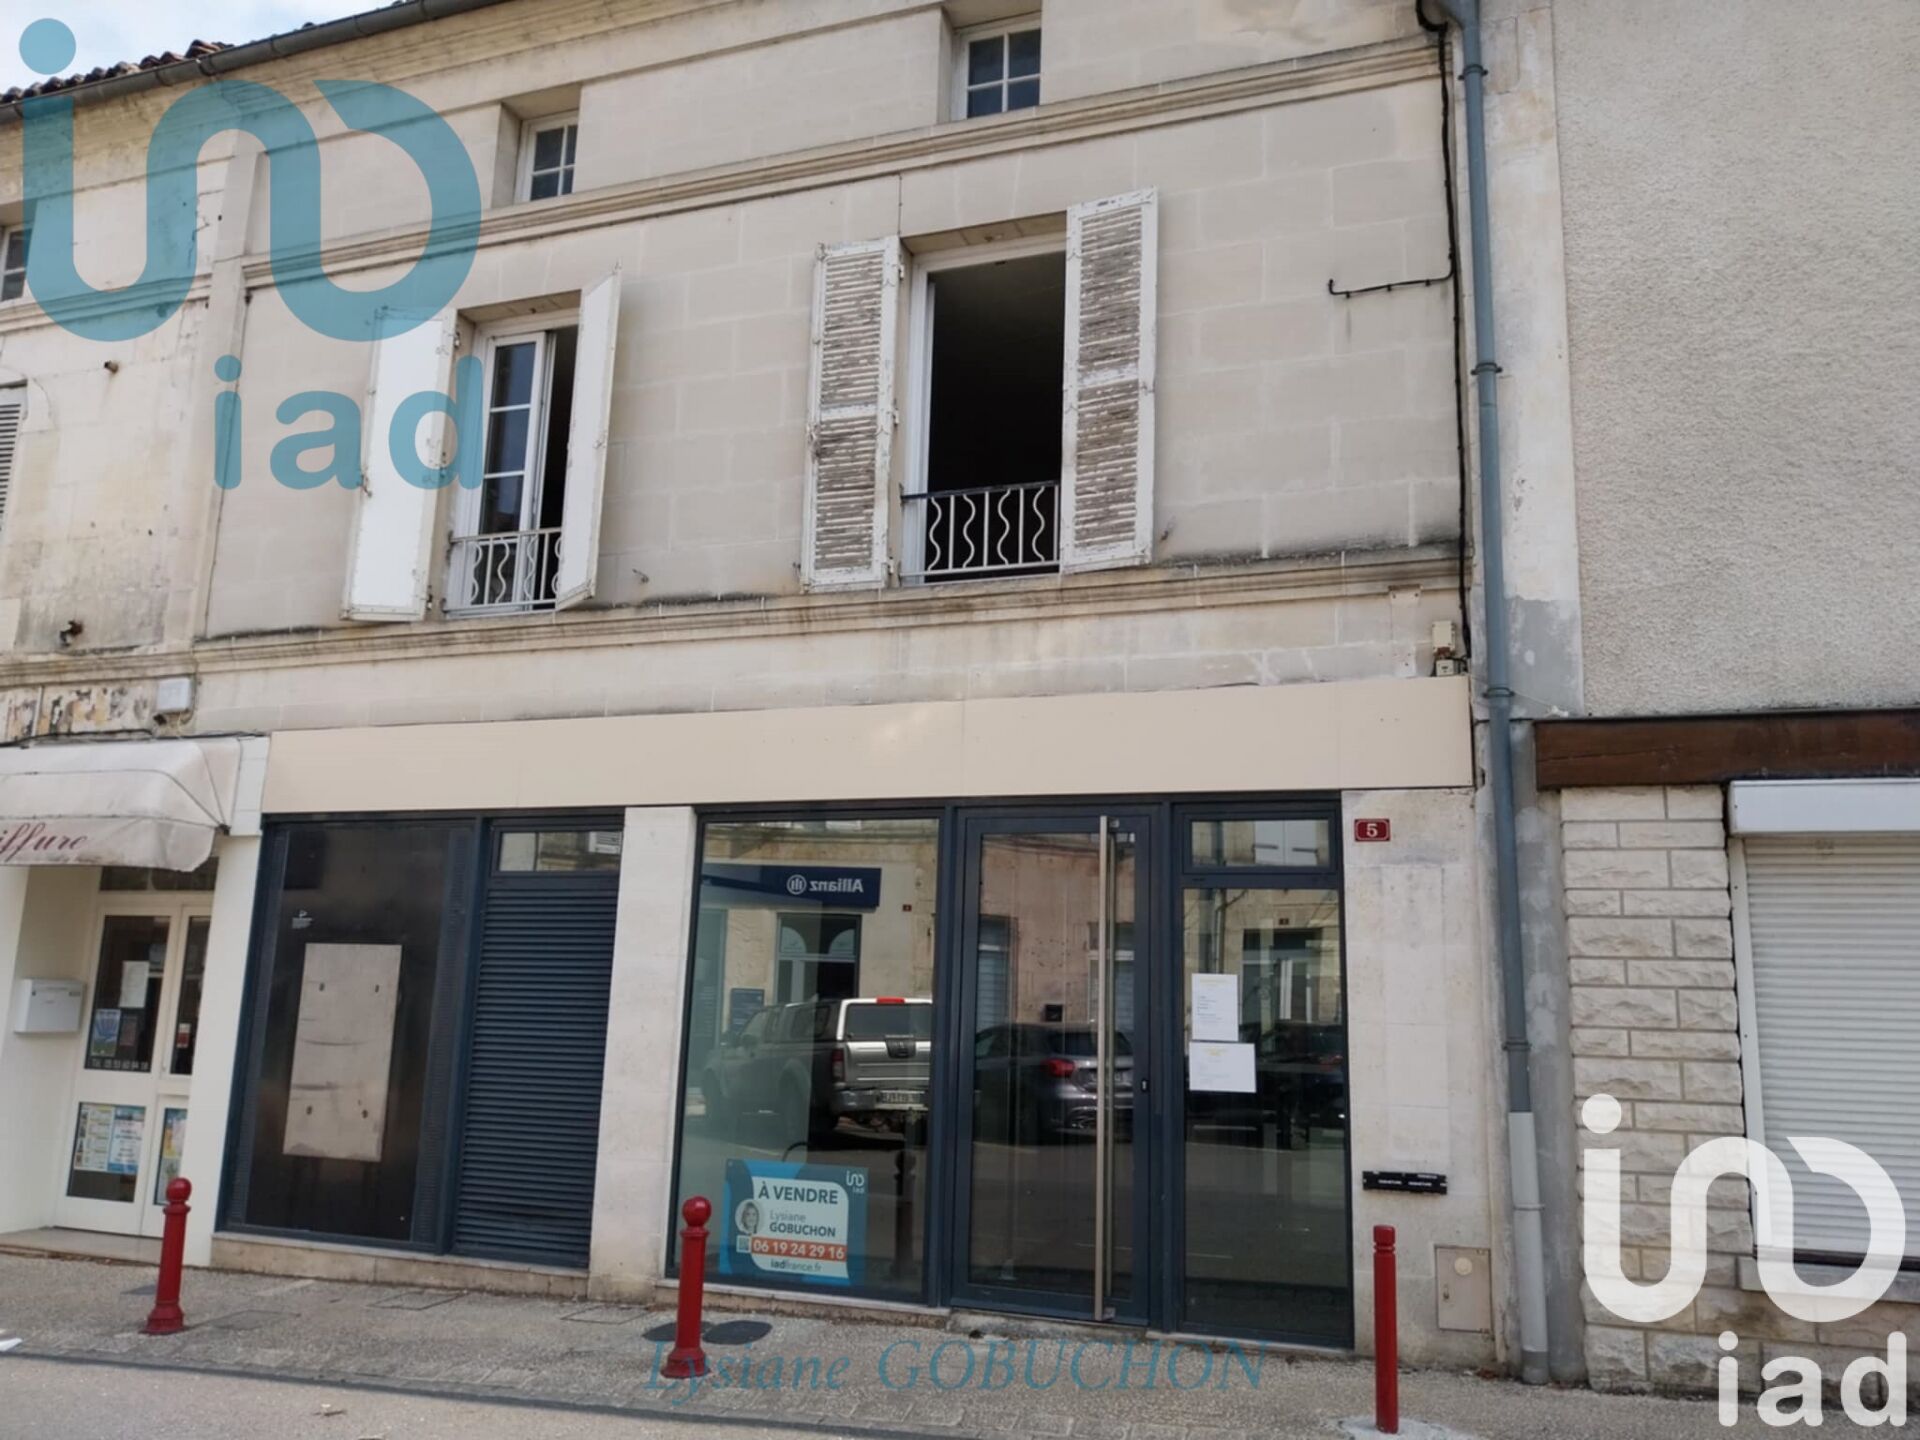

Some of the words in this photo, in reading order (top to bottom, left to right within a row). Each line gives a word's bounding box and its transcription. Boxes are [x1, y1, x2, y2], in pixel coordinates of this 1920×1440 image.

[1366, 823, 1378, 838] 5
[759, 1181, 770, 1199] À
[773, 1186, 838, 1204] VENDRE
[770, 1210, 806, 1223] Lysiane
[770, 1222, 836, 1237] GOBUCHON
[753, 1239, 769, 1253] 06
[773, 1241, 788, 1254] 19
[789, 1243, 806, 1256] 24
[810, 1244, 825, 1257] 29
[829, 1246, 845, 1260] 16
[771, 1260, 822, 1272] iadfrance.fr
